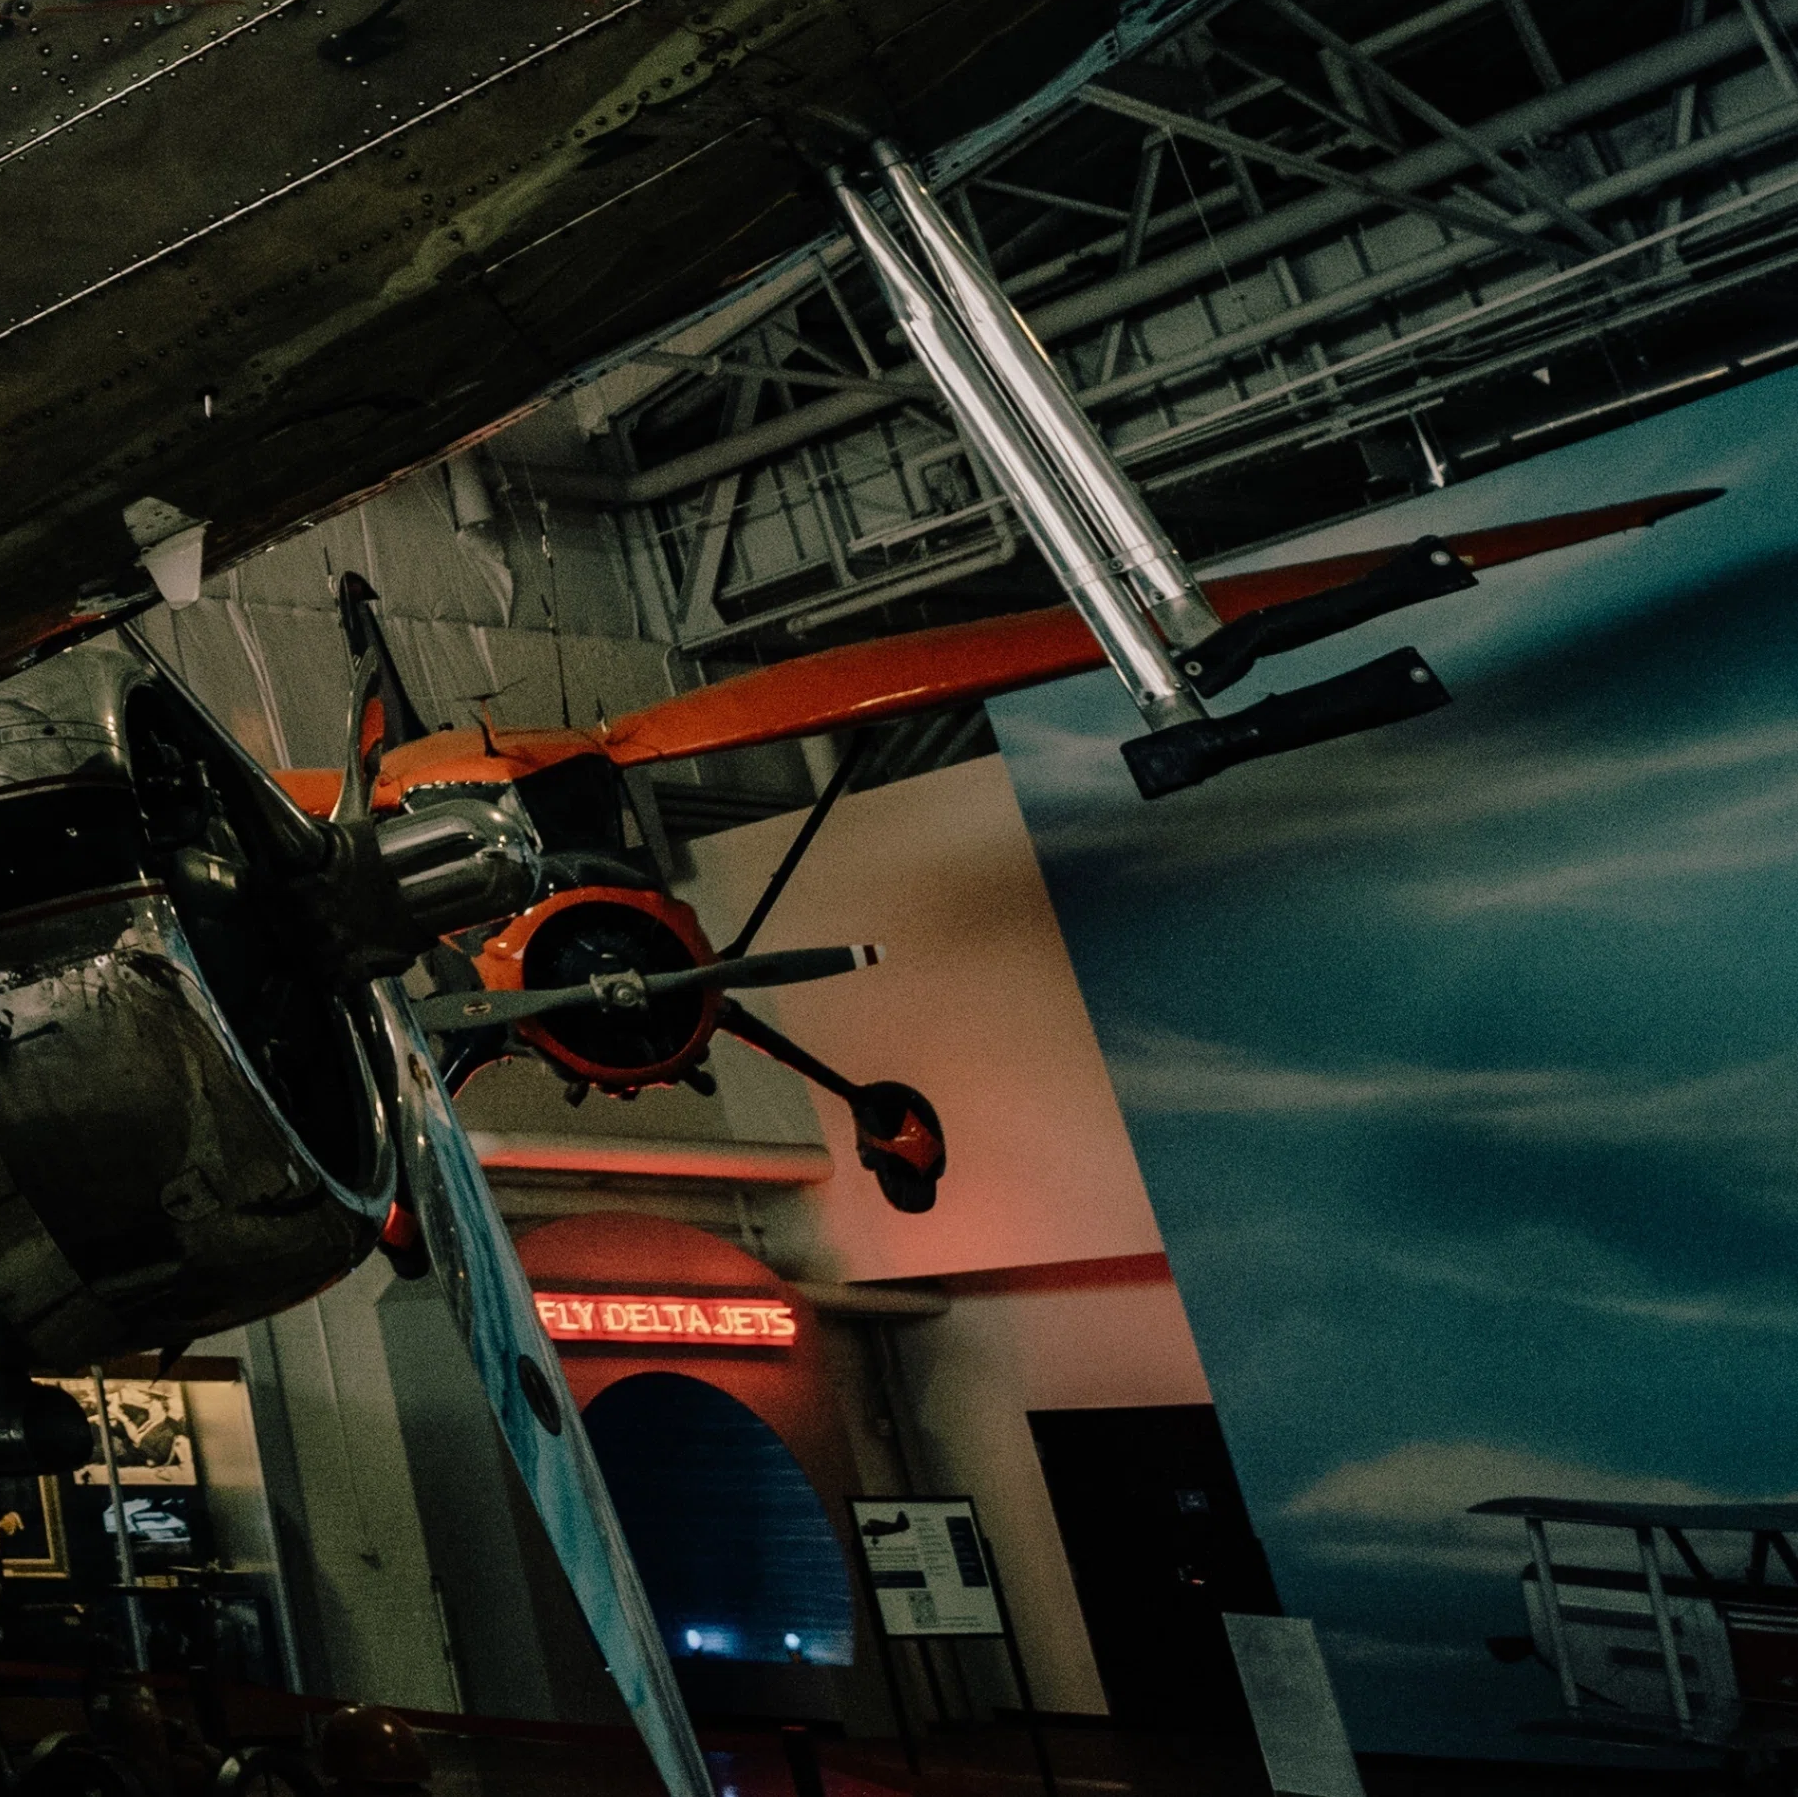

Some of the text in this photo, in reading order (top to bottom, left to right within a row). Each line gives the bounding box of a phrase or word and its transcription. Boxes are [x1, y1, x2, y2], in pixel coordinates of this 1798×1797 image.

[535, 1300, 796, 1337] FLY DELTA JETS
